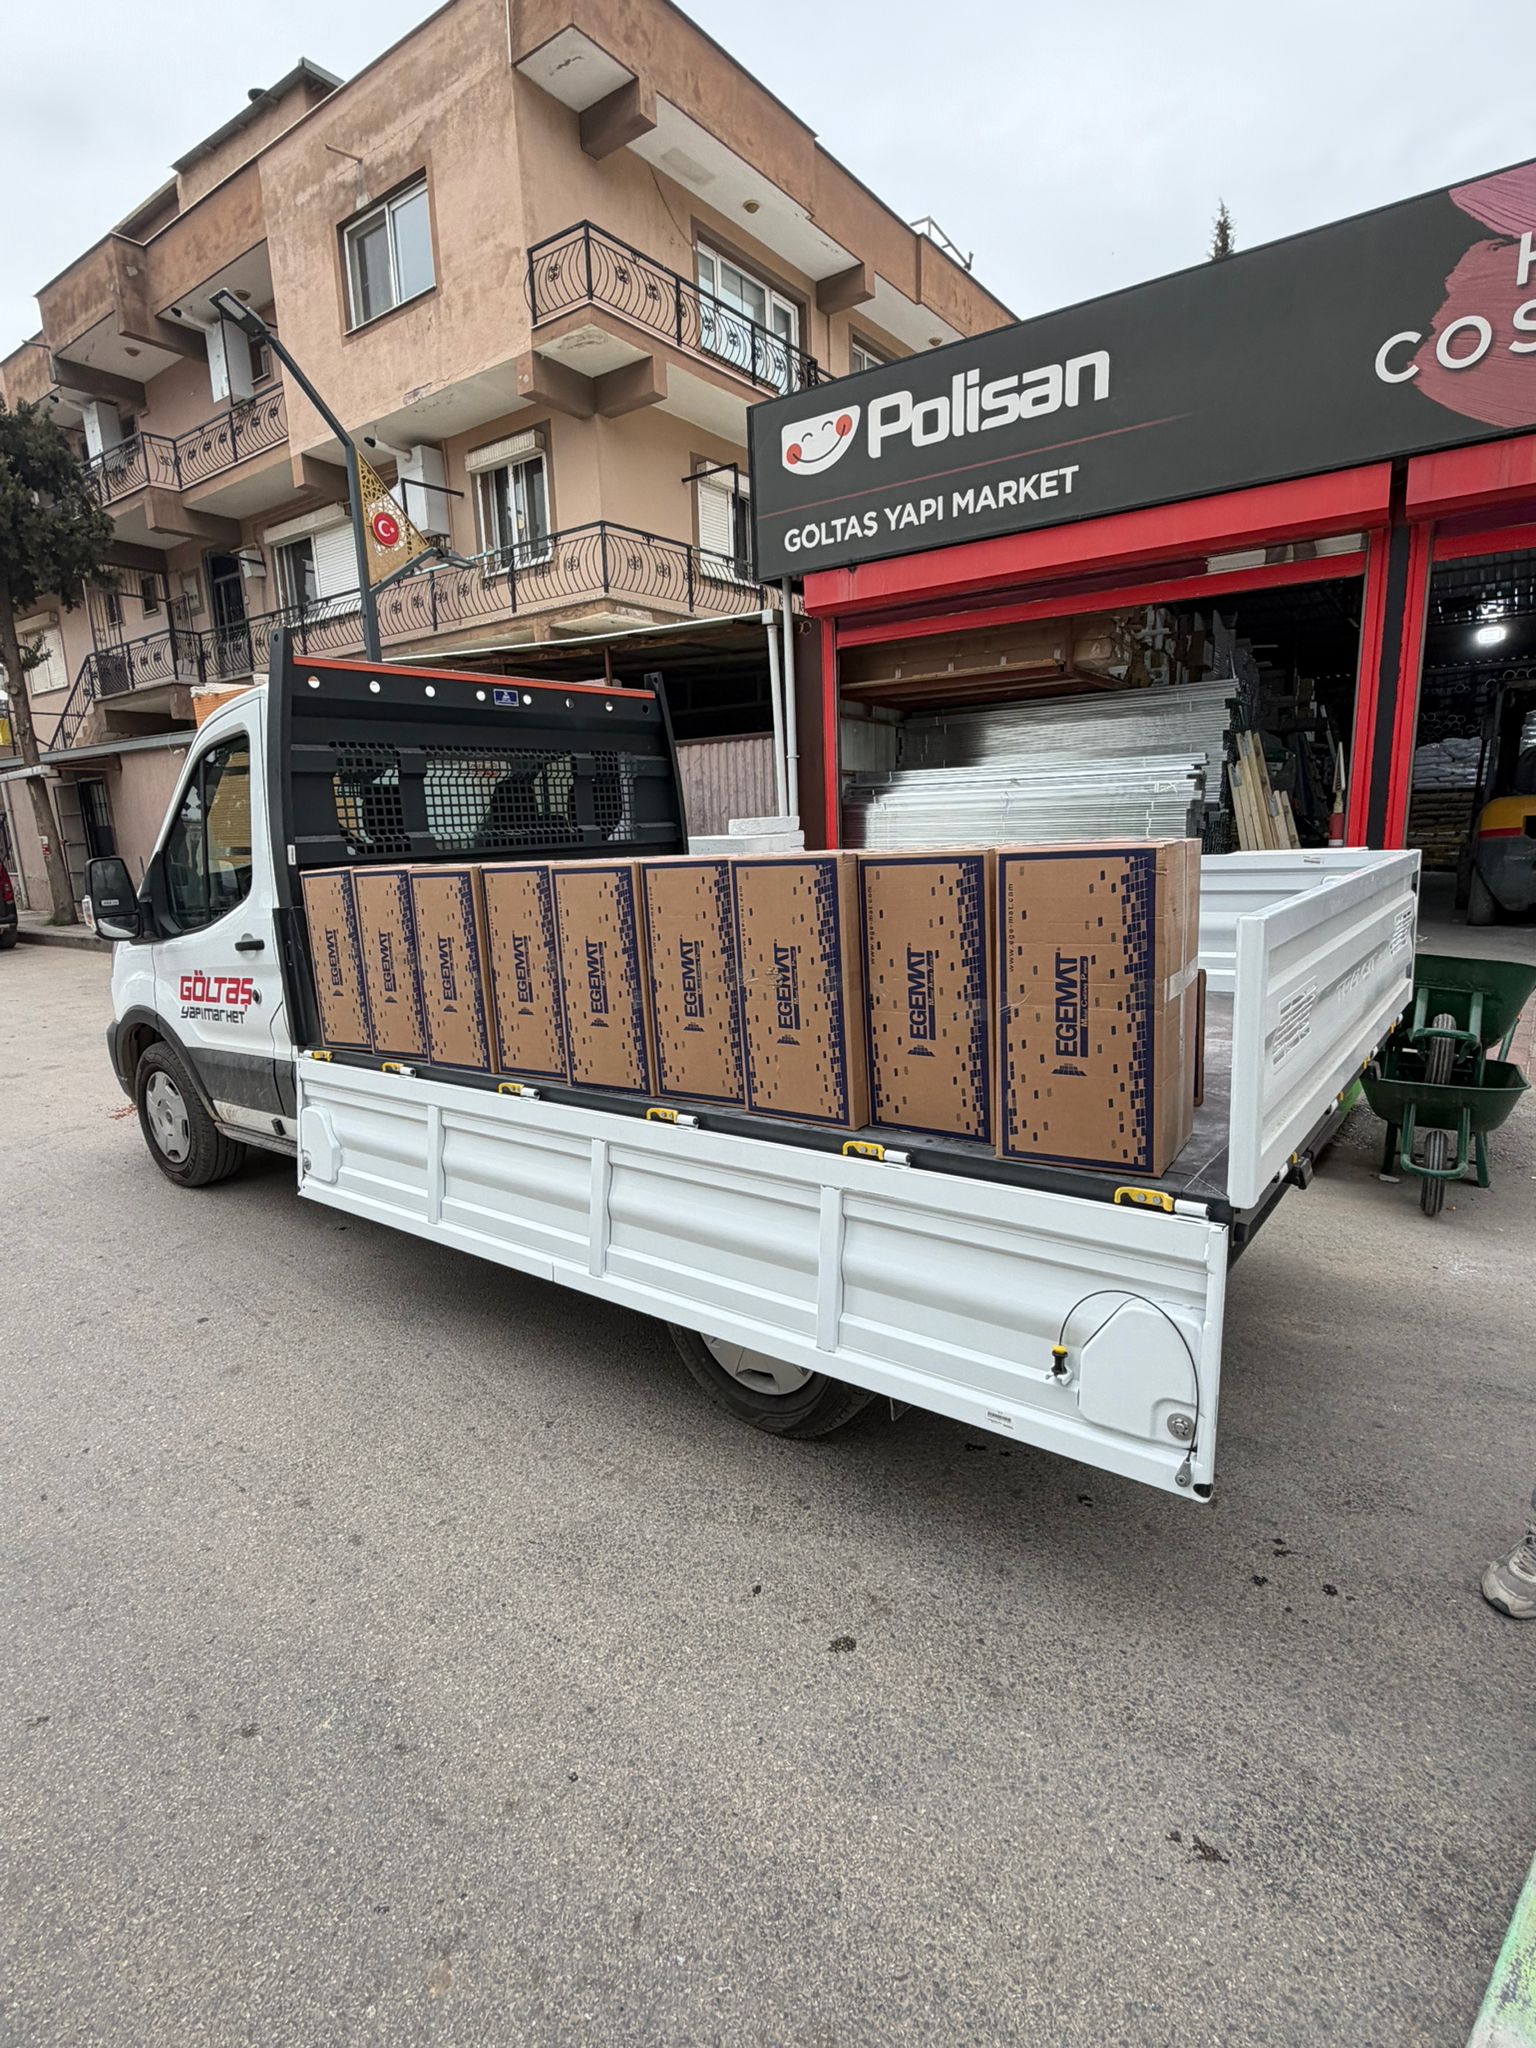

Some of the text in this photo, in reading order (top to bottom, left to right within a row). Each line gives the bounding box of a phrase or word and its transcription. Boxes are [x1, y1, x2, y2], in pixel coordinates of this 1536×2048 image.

[868, 350, 1110, 459] Polisan
[784, 465, 1079, 552] GÖLTAŞ YAPI MARKET
[378, 931, 393, 992] EGEMAT
[438, 935, 452, 1000] EGEMAT
[512, 933, 528, 1002] EGEMAT
[586, 939, 603, 1014] EGEMAT
[680, 938, 698, 1017] EGEMAT
[774, 943, 793, 1029] EGEMAT
[907, 947, 927, 1040] EGEMAT
[1056, 952, 1078, 1057] EGEMAT
